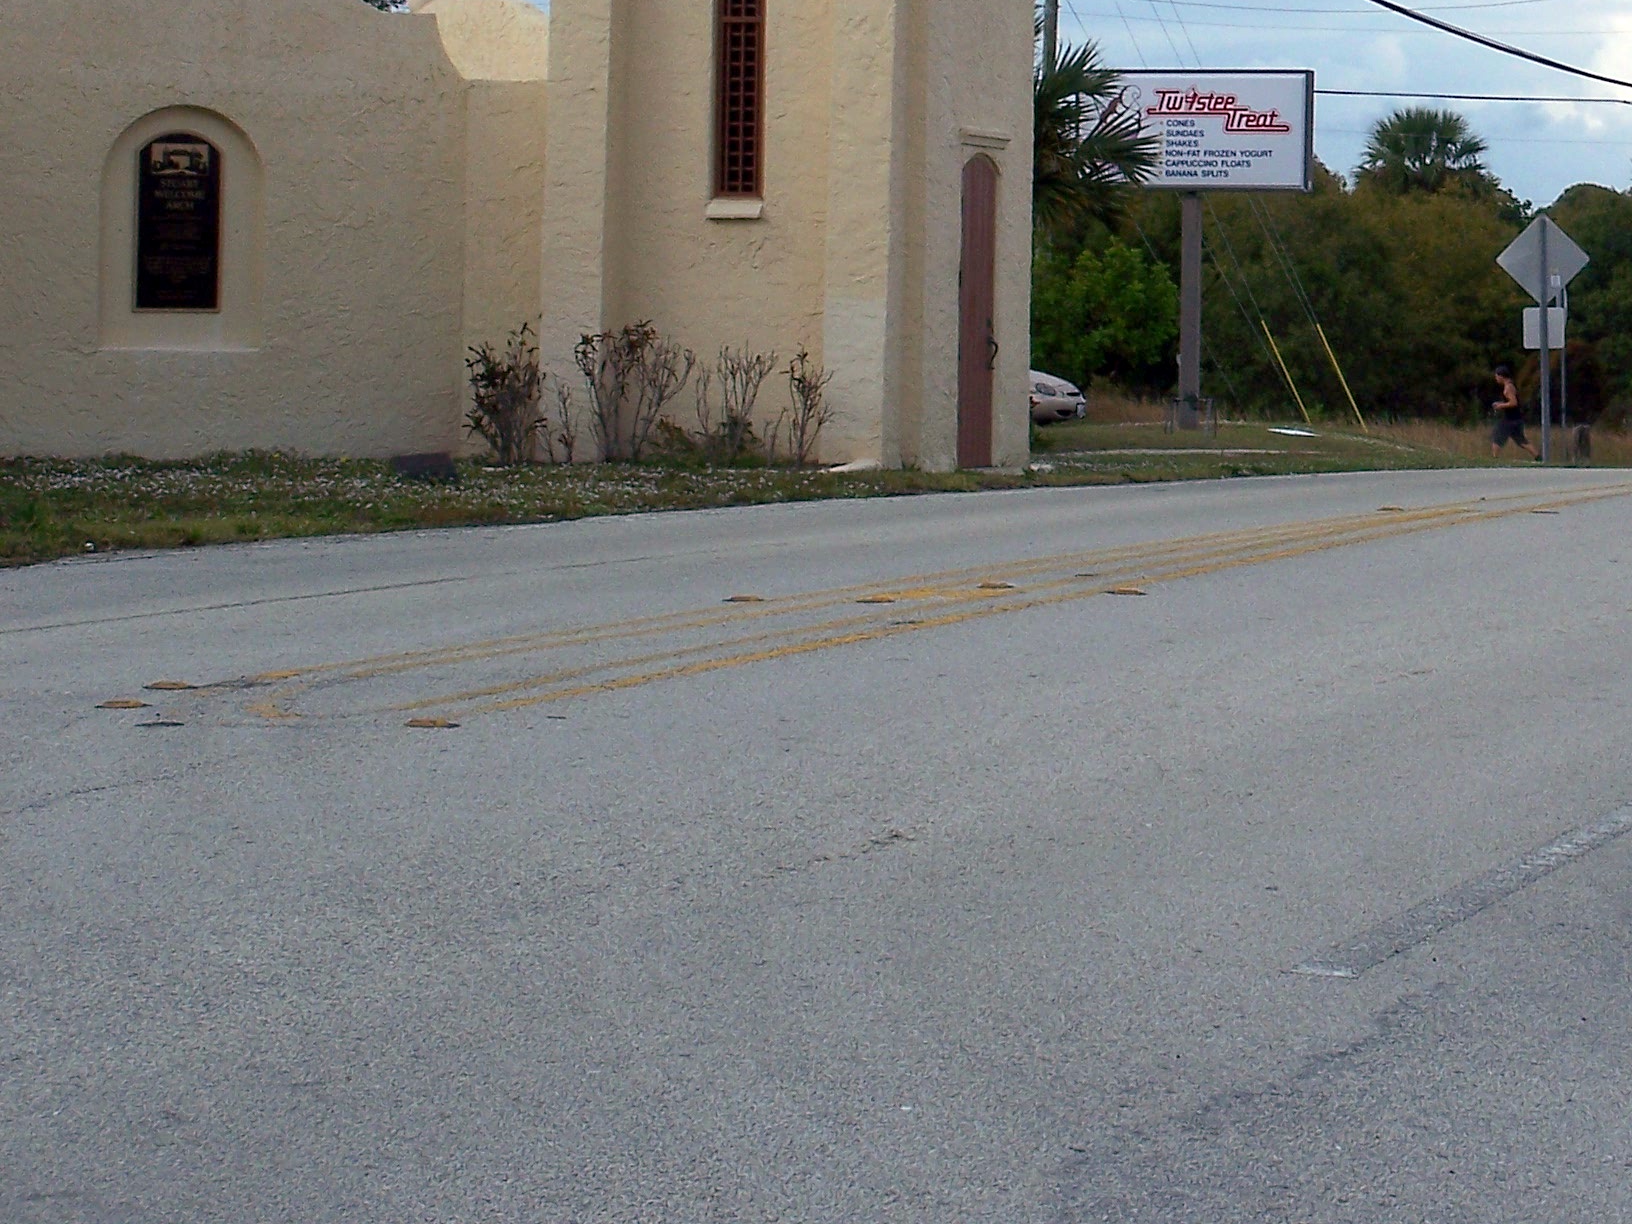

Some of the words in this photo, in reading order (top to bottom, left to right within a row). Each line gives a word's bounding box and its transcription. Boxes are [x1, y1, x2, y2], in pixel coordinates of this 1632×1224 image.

[1152, 87, 1239, 113] Twistee
[1166, 119, 1196, 127] CONES
[1228, 108, 1284, 130] Treat
[1165, 129, 1205, 137] SUNDAES
[1165, 139, 1199, 147] SHAKES
[1165, 149, 1201, 157] NON-FAT
[1203, 149, 1237, 157] FROZEN
[1240, 149, 1273, 157] YOGURT
[1165, 159, 1219, 167] CAPPUCCINO
[1221, 159, 1252, 167] FLOATS
[1165, 169, 1199, 177] BANANA
[1201, 169, 1230, 177] SPLITS
